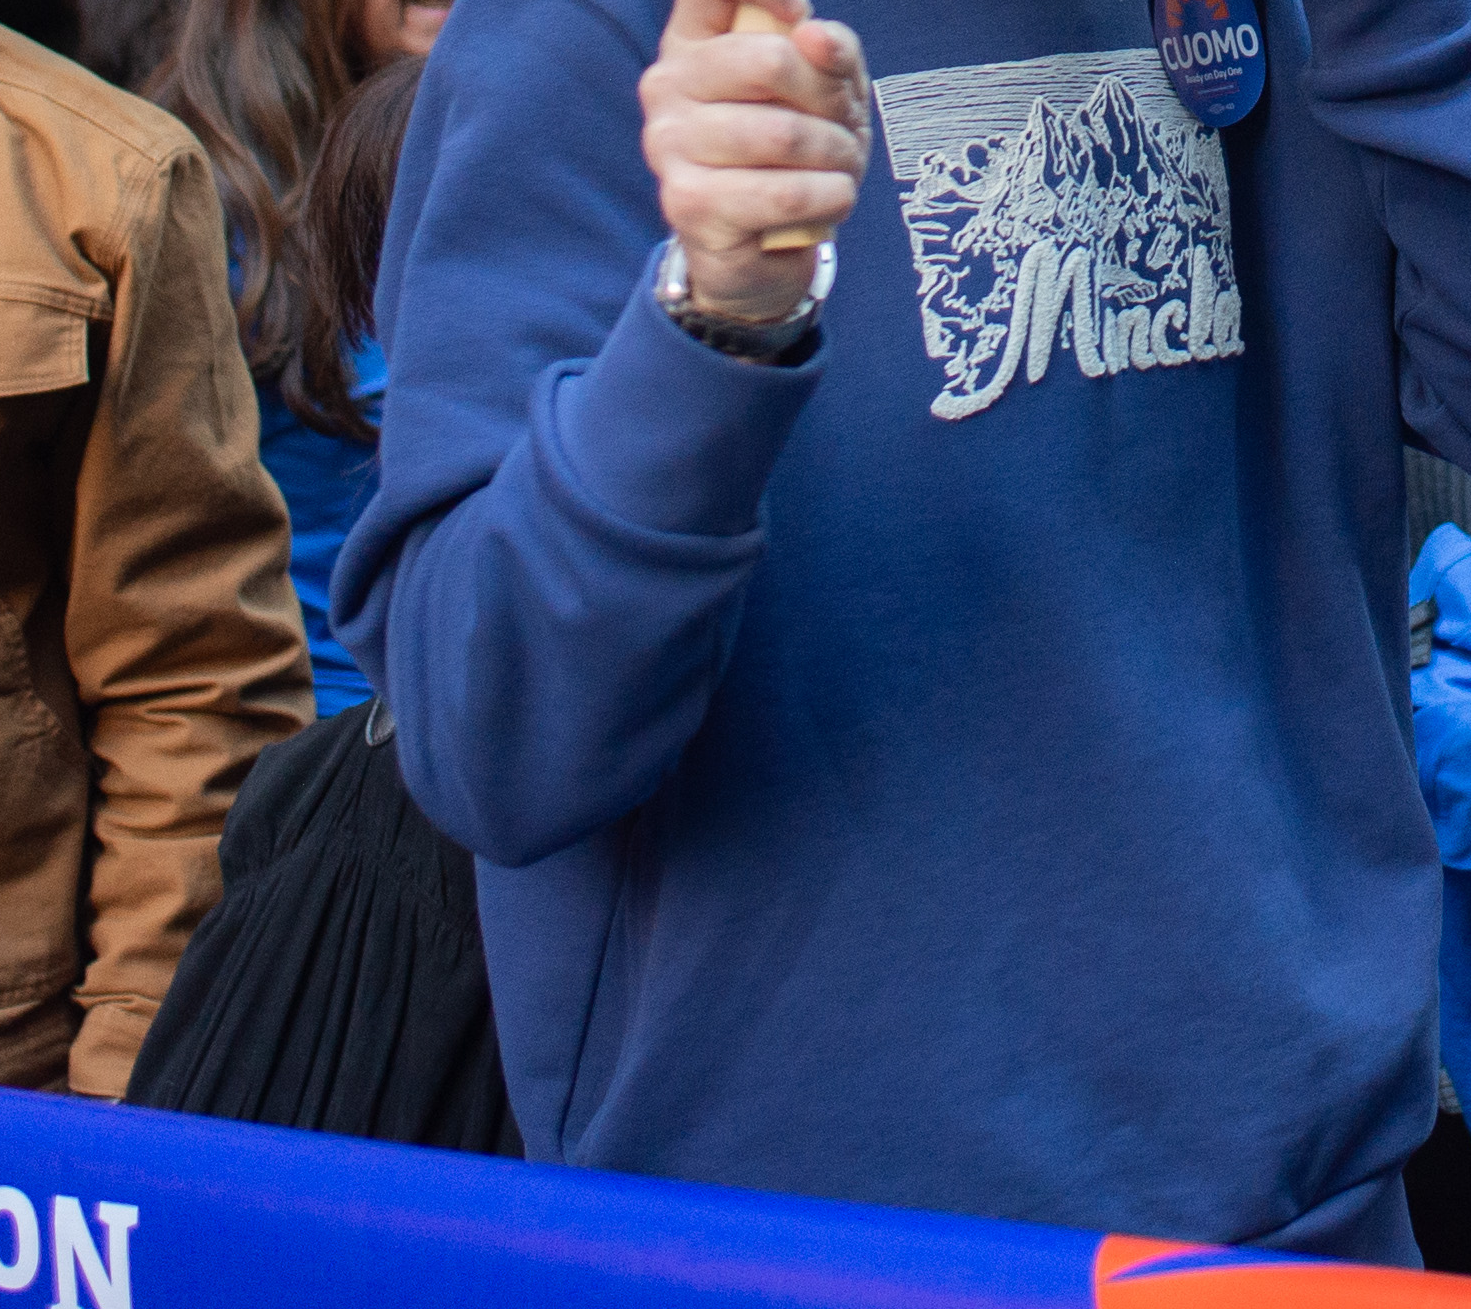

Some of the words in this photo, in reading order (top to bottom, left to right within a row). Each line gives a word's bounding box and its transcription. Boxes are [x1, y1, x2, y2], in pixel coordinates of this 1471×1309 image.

[1161, 23, 1260, 71] CUOMO
[1214, 69, 1228, 80] Day
[1228, 66, 1243, 76] One
